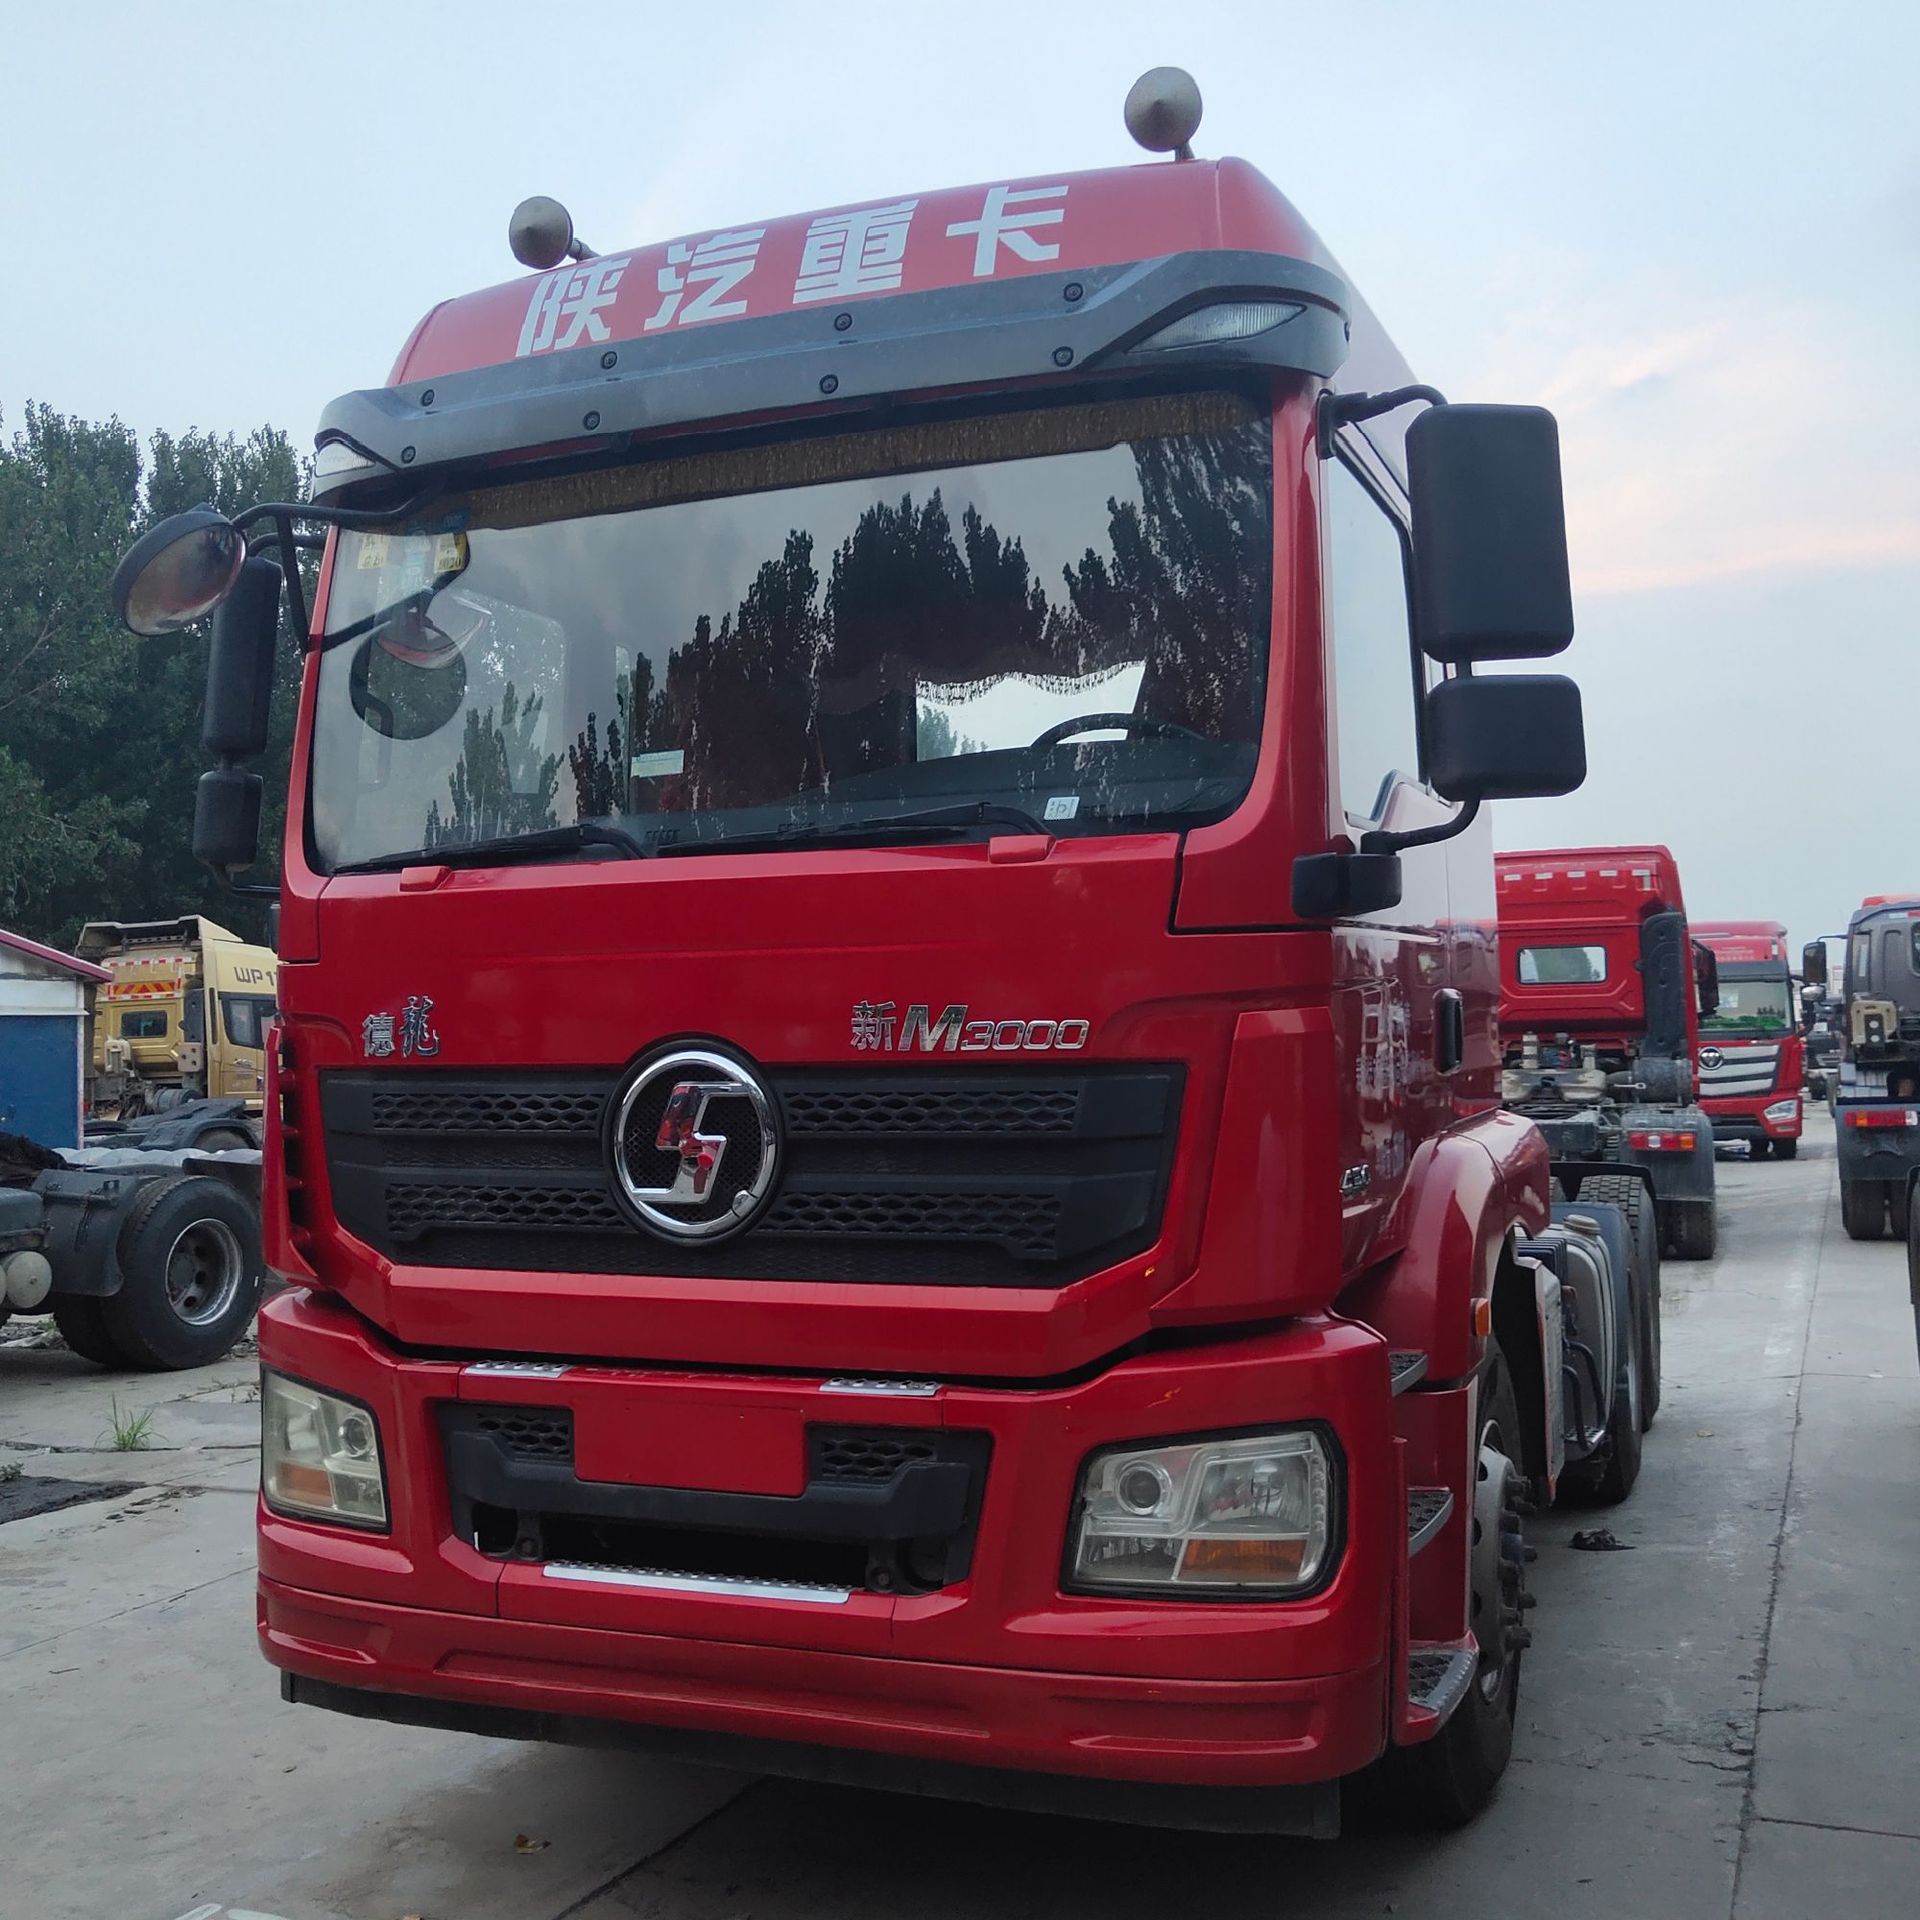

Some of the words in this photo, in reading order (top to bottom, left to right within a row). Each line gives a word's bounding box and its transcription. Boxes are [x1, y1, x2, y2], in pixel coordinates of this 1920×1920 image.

[515, 185, 1069, 358] 陕汽重卡
[233, 966, 277, 986] WP1
